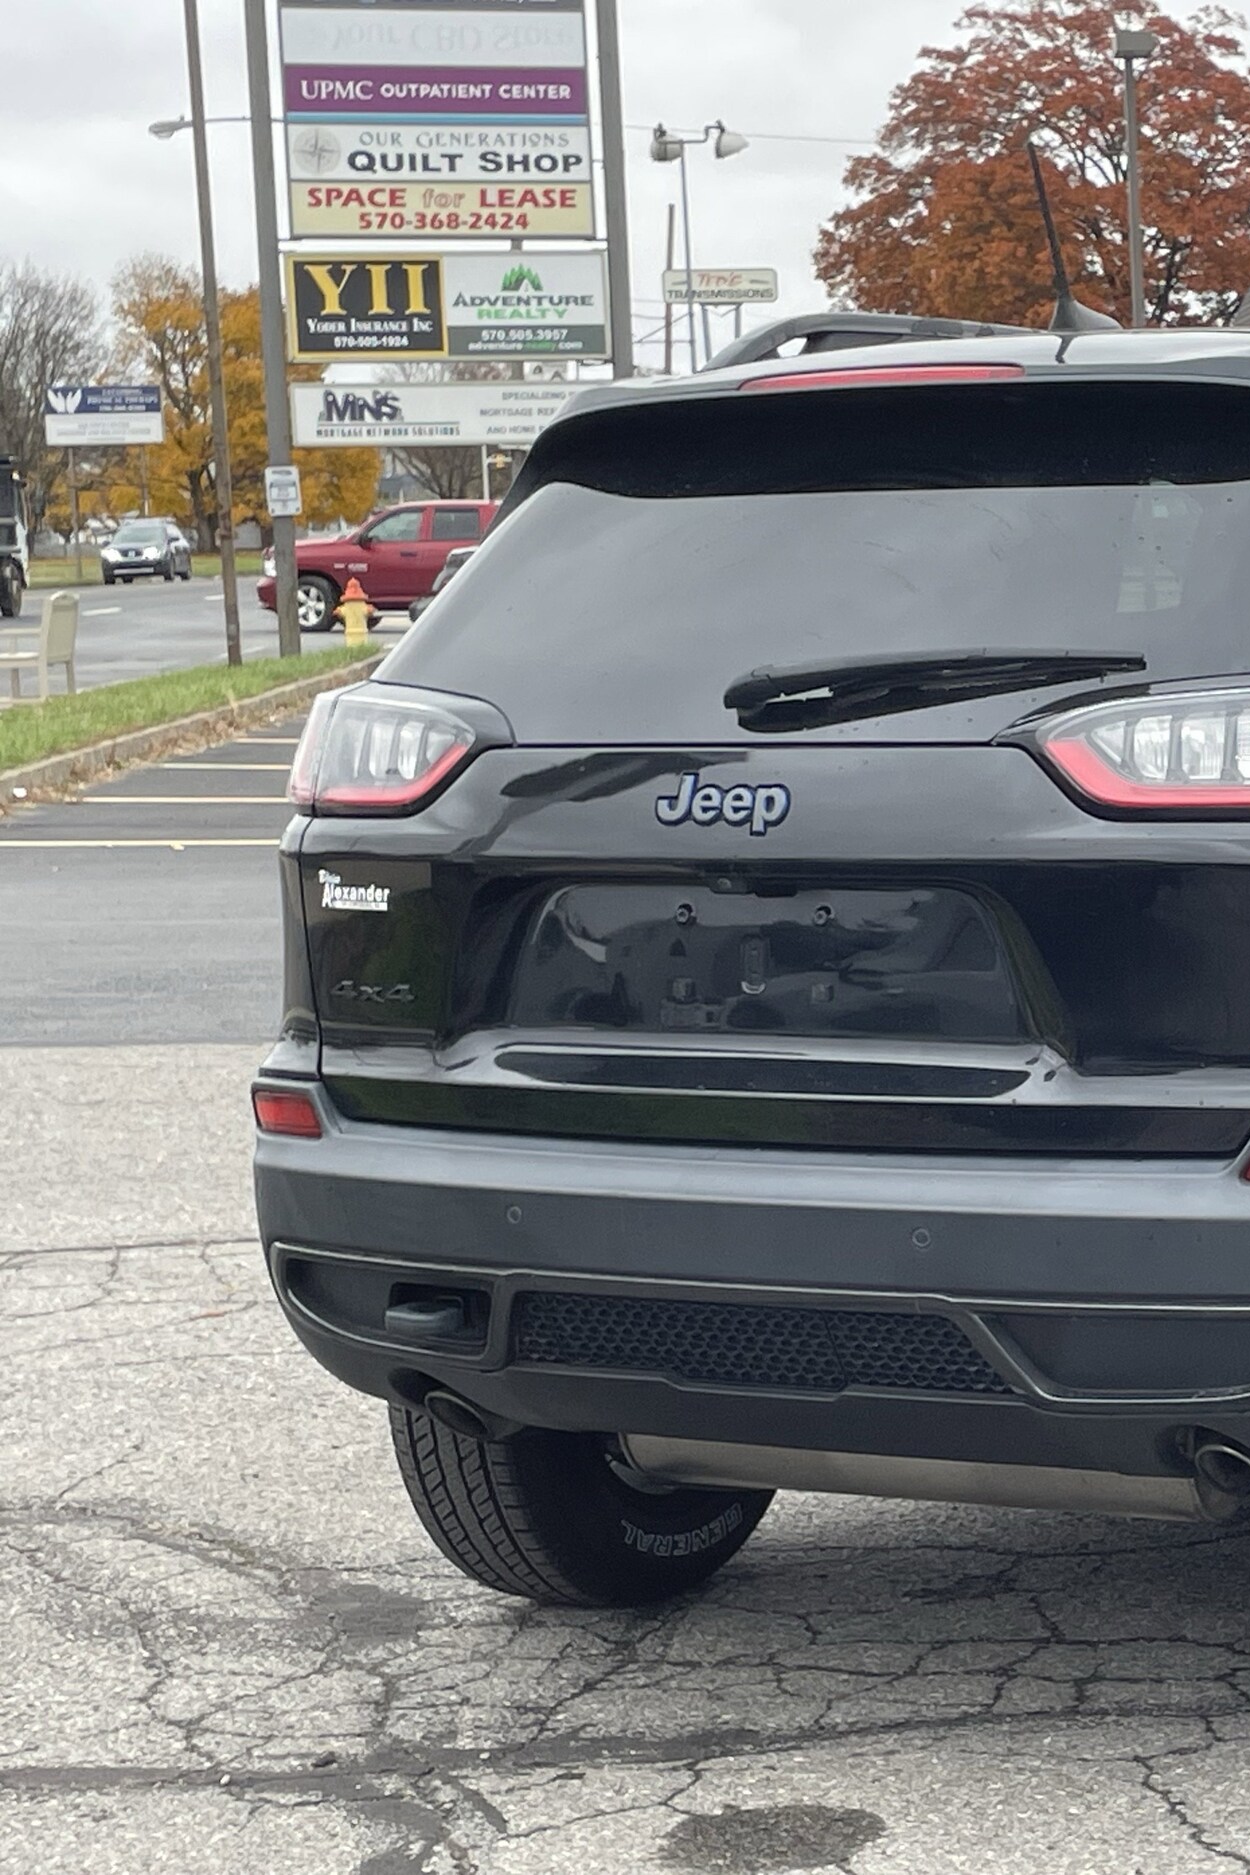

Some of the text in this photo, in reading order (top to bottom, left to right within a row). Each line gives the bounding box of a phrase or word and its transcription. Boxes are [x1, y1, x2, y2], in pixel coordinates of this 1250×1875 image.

[301, 80, 572, 101] UPMC OUTPATIENT CENTER
[359, 130, 570, 148] OUR GENERATIONS
[347, 150, 583, 175] QUILT SHOP
[307, 187, 578, 209] SPACE for LEASE
[358, 211, 530, 231] 570-368-2424
[303, 263, 433, 316] YII
[452, 291, 595, 308] ADVENTURE
[476, 307, 569, 320] REALTY
[656, 772, 791, 836] Jeep
[620, 1502, 743, 1557] GENERAL
